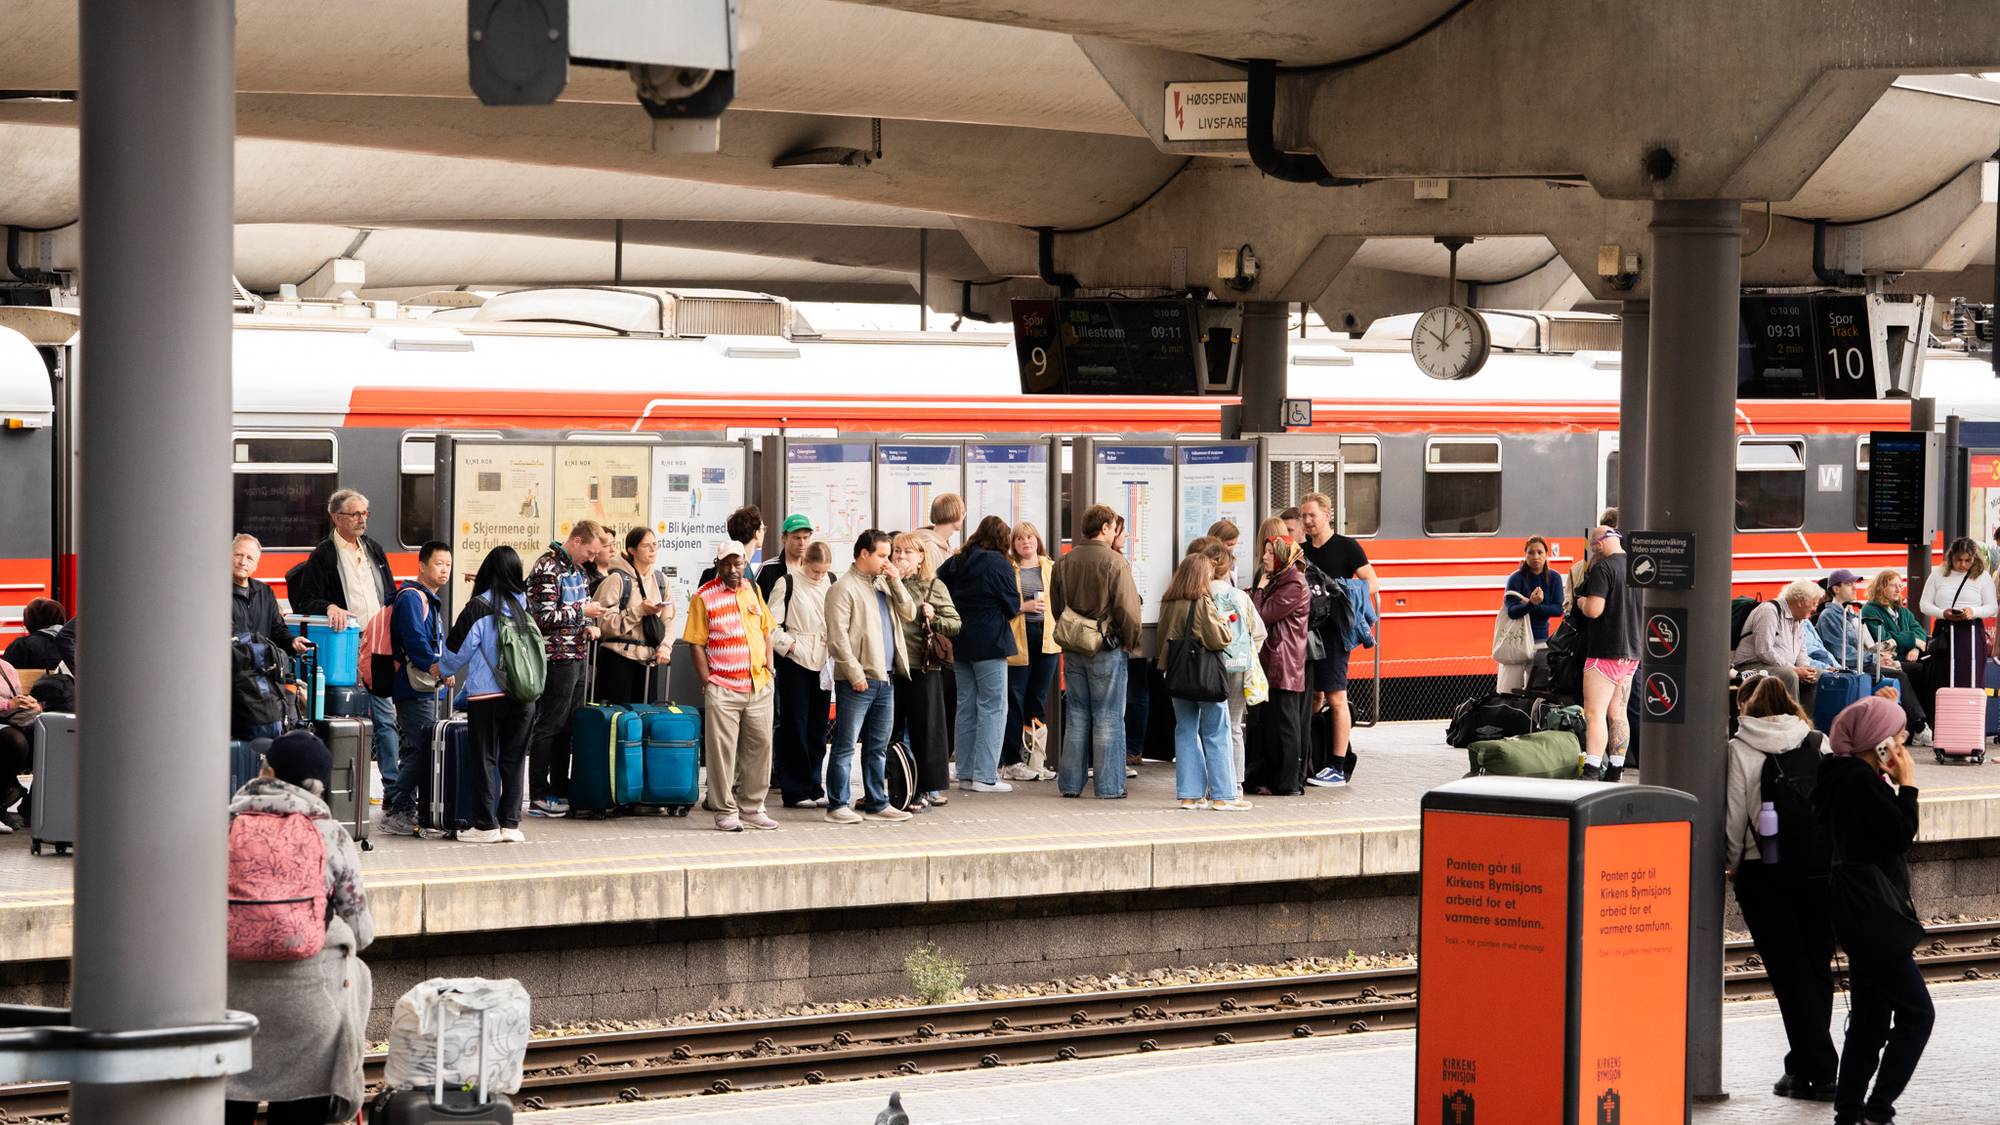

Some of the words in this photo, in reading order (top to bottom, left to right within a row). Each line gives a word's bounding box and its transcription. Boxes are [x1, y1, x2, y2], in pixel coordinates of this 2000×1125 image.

[1186, 92, 1247, 105] HØGSPENNI
[1198, 117, 1248, 129] LIVSFARE
[1023, 314, 1045, 326] Spor
[1828, 313, 1853, 325] Spor
[1072, 325, 1126, 338] Lillestrøm
[1151, 326, 1182, 338] 09:11
[1767, 325, 1800, 338] 09:31
[1831, 325, 1859, 337] Track
[1777, 343, 1784, 354] 2
[1786, 343, 1804, 353] min
[1031, 346, 1048, 376] 9
[1827, 347, 1865, 380] 10
[473, 522, 525, 536] Skjermene
[527, 522, 540, 537] gir
[668, 521, 679, 533] Bli
[681, 521, 705, 536] kjent
[706, 521, 726, 533] med
[462, 537, 480, 552] deg
[657, 537, 702, 551] stasjonen
[1632, 537, 1687, 547] Kameraovervåking
[1650, 546, 1685, 554] surveillance
[1446, 857, 1484, 872] Panten
[1488, 861, 1507, 876] går
[1511, 863, 1521, 874] til
[1600, 870, 1629, 882] Panten
[1631, 868, 1646, 884] går
[1648, 867, 1656, 879] til
[1446, 875, 1485, 889] Kirkens
[1489, 878, 1543, 895] Bymisjons
[1600, 886, 1629, 899] Kirkens
[1631, 885, 1672, 900] Bymisjons
[1446, 894, 1482, 907] arbeid
[1486, 896, 1501, 908] for
[1505, 899, 1516, 909] et
[1600, 904, 1627, 917] arbeid
[1629, 904, 1640, 915] for
[1643, 904, 1651, 914] et
[1445, 913, 1490, 925] varmere
[1494, 916, 1544, 929] samfunn.
[1600, 924, 1633, 935] varmere
[1635, 920, 1673, 932] samfunn.
[1442, 1056, 1476, 1071] KIRKENS
[1442, 1070, 1476, 1086] BYMISJON
